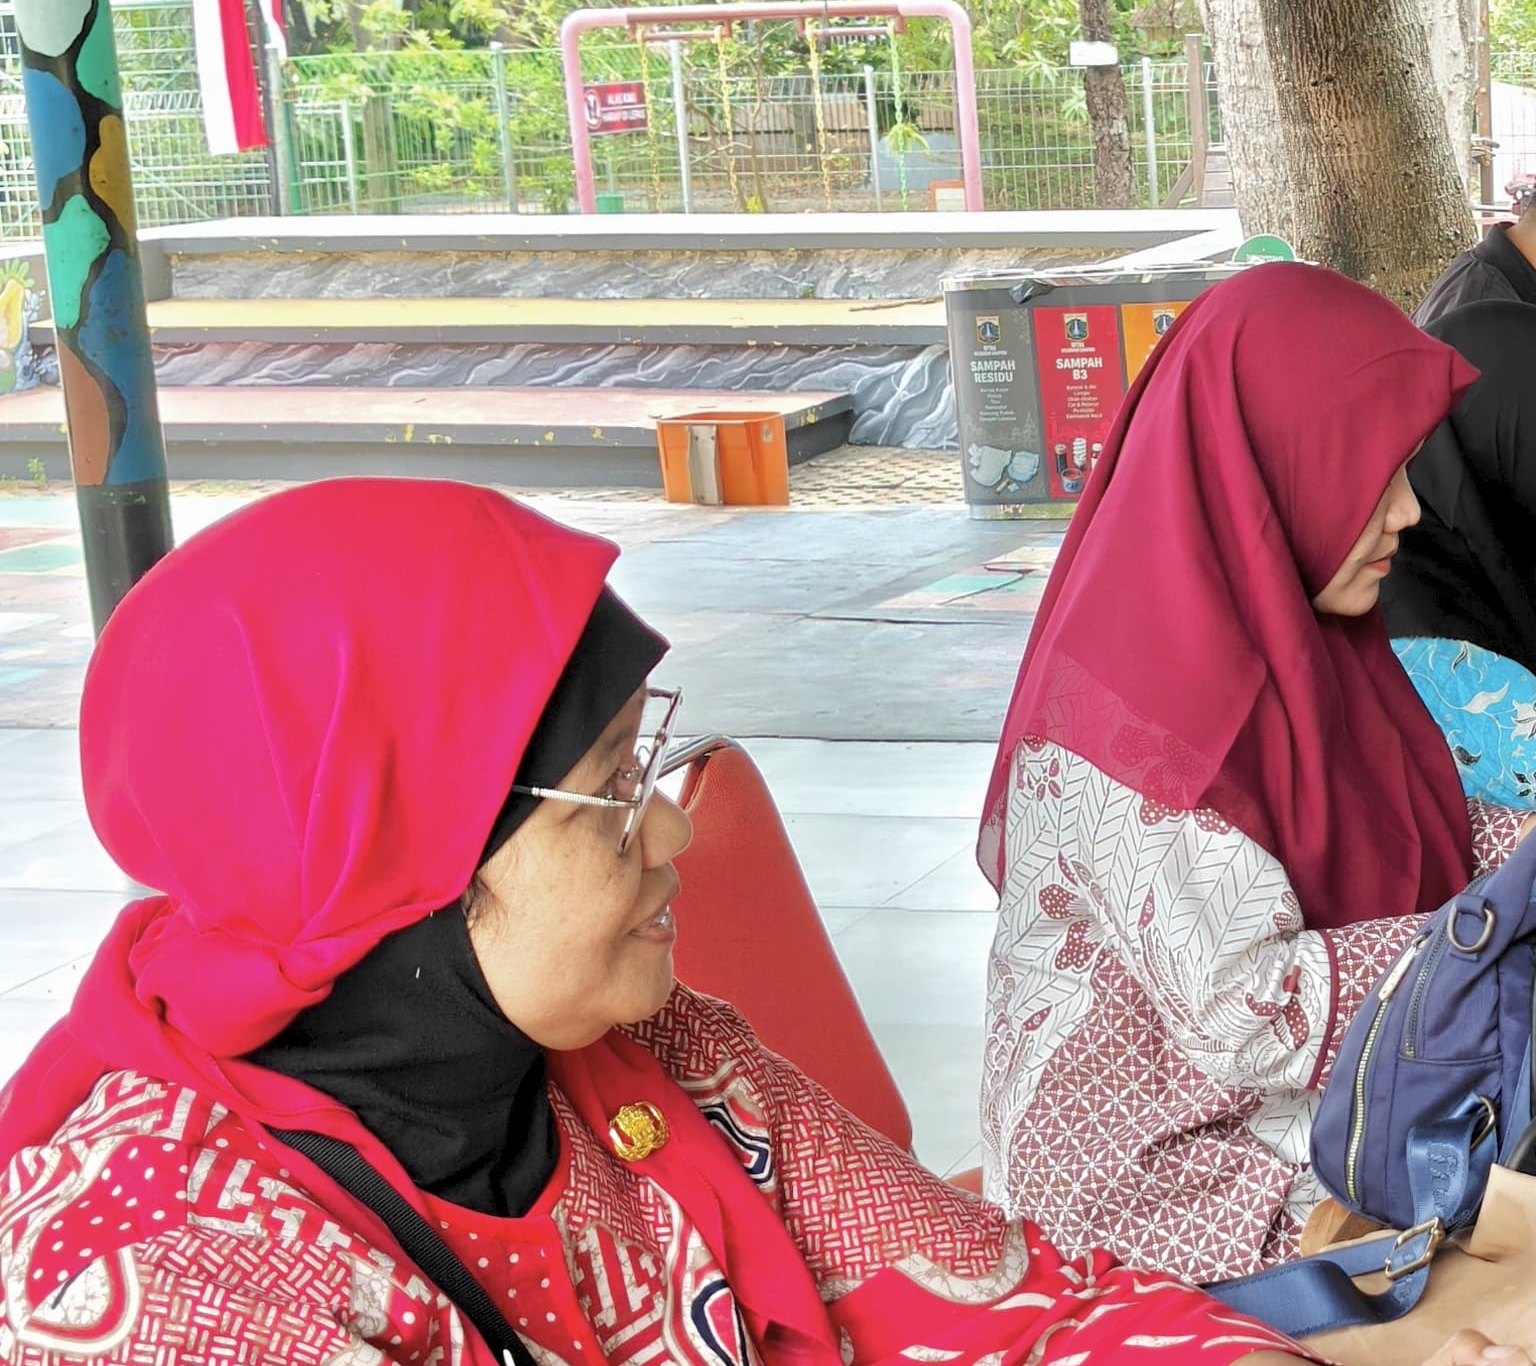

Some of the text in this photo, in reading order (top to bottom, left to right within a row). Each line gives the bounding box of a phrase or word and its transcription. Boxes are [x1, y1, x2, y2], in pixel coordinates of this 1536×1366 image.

[970, 359, 1016, 373] SAMPAH
[1056, 356, 1103, 370] SAMPAH
[974, 372, 1014, 384] RESIDU
[1072, 369, 1088, 380] B3
